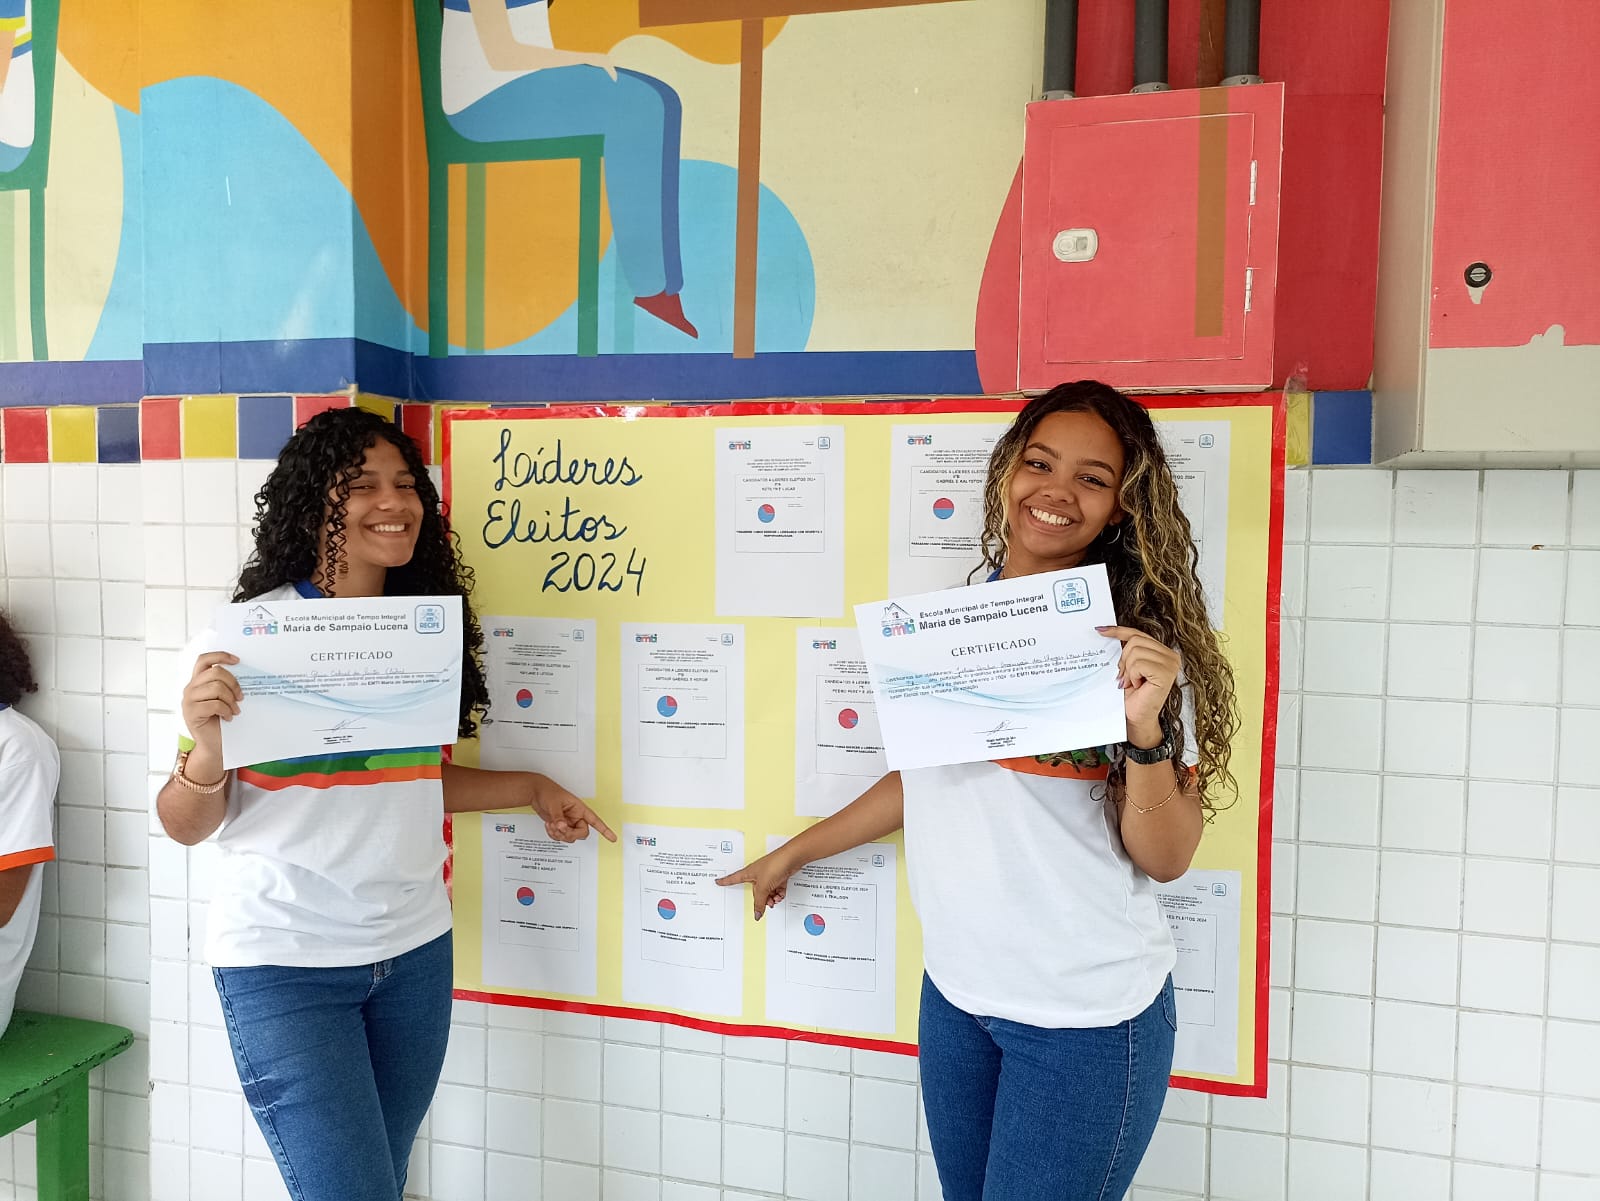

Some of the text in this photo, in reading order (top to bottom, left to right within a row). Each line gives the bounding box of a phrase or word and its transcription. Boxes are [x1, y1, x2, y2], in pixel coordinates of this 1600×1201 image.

[493, 428, 643, 491] Líderes
[482, 496, 628, 549] Eleitos
[542, 547, 646, 596] 2024
[920, 609, 943, 619] Escola
[944, 604, 978, 615] Municipal
[990, 599, 1014, 608] Tempo
[1016, 594, 1044, 604] Integral
[1061, 597, 1085, 608] RECIFE
[381, 613, 406, 621] Integral
[419, 621, 440, 629] RECIFE
[919, 604, 1048, 630] Maria de Sampaio Lucena
[243, 621, 278, 635] emti
[283, 622, 408, 633] Maria de Sampaio Lucena
[882, 618, 916, 637] emti
[310, 650, 393, 662] CERTIFICADO
[951, 637, 1037, 657] CERTIFICADO
